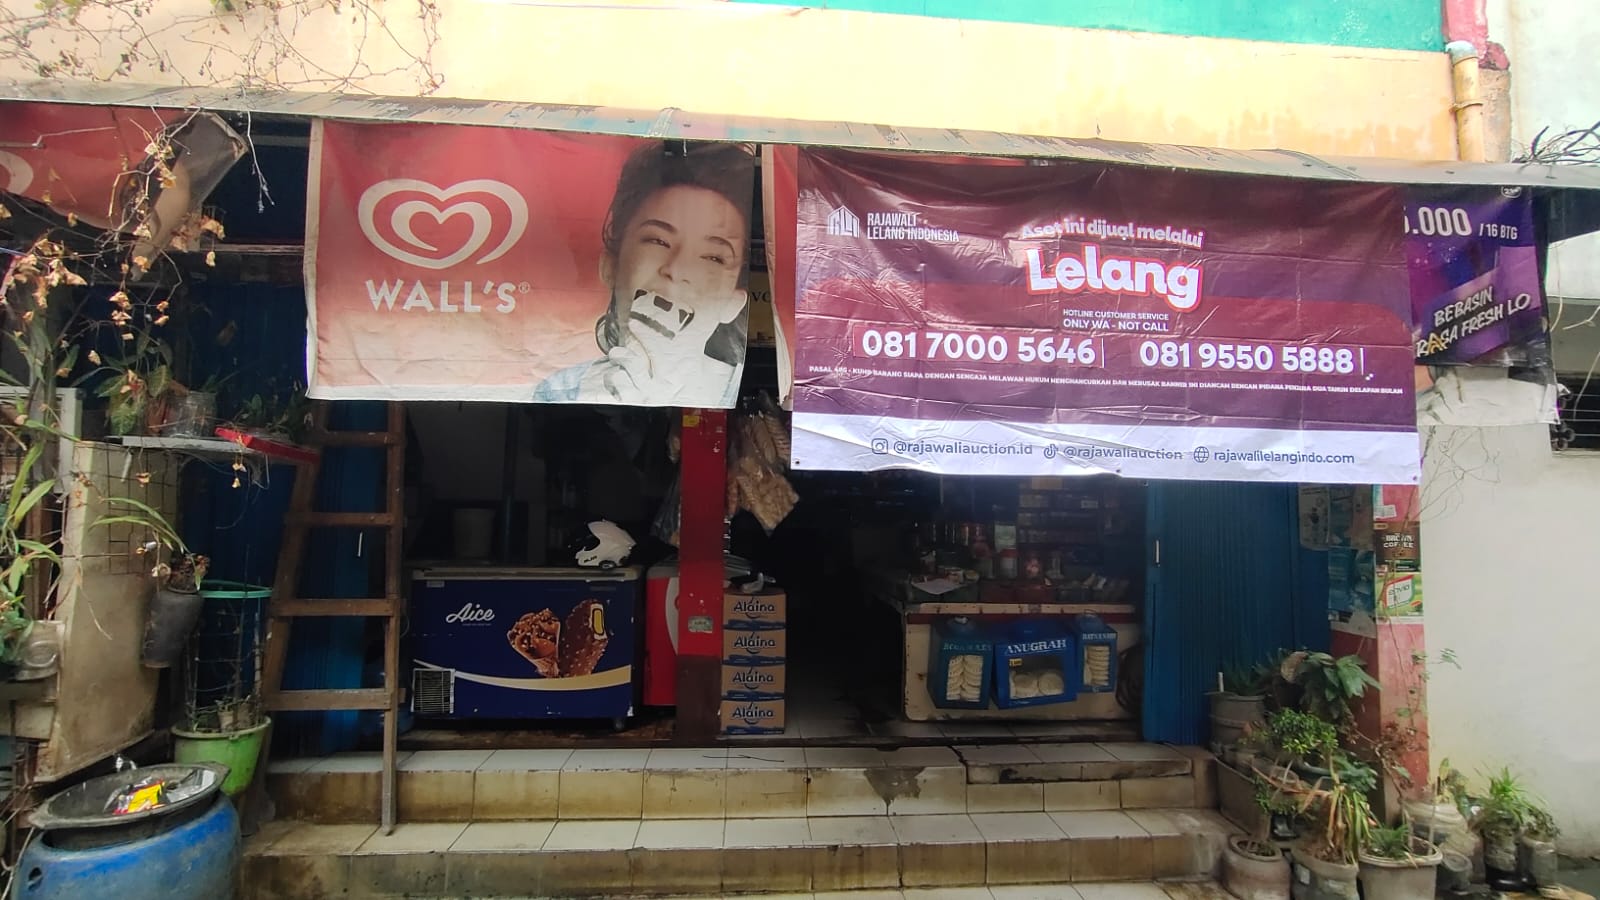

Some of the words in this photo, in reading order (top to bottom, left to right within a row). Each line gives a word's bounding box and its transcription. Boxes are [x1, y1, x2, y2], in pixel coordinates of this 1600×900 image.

[867, 213, 918, 226] RAJAWALI
[1405, 206, 1472, 236] .000
[1500, 224, 1518, 240] BTG
[867, 227, 905, 240] LELANG
[907, 228, 960, 242] INDONESIA
[1022, 221, 1063, 239] Aset
[1064, 217, 1085, 234] ini
[1087, 219, 1134, 238] dijual
[1137, 225, 1204, 248] melalui
[1026, 245, 1201, 309] Lelang
[365, 280, 517, 313] WALL'S
[1063, 309, 1094, 318] HOTLINE
[1095, 310, 1137, 320] CUSTOMER
[1138, 313, 1169, 321] SERVICE
[1434, 286, 1494, 328] BEBASIN
[1063, 319, 1090, 329] ONLY
[1091, 320, 1110, 330] WA
[1118, 321, 1141, 331] NOT
[1142, 322, 1169, 332] CALL
[1416, 323, 1458, 358] RASA
[1460, 303, 1503, 338] FRESH
[1507, 293, 1531, 317] LO
[862, 329, 917, 358] 081
[925, 331, 1008, 361] 7000
[1017, 336, 1096, 365] 5646
[1140, 340, 1191, 368] 081
[1198, 343, 1274, 371] 9550
[1282, 346, 1354, 374] 5888
[809, 365, 832, 373] PASAL
[903, 371, 923, 379] SIAPA
[925, 371, 954, 380] DENGAN
[956, 373, 987, 381] SENGAJA
[988, 374, 1024, 382] MELAWAN
[893, 439, 1033, 457] @rajawaliauction.id
[1063, 445, 1183, 462] @rajawaliauction
[1214, 449, 1355, 465] rajawalilelangindo.com
[445, 602, 495, 623] Aice
[733, 599, 775, 613] Alaina
[733, 635, 776, 649] Alaina
[1007, 639, 1067, 654] ANUGRAH
[732, 670, 774, 684] Alaina
[732, 705, 774, 719] Alaina
